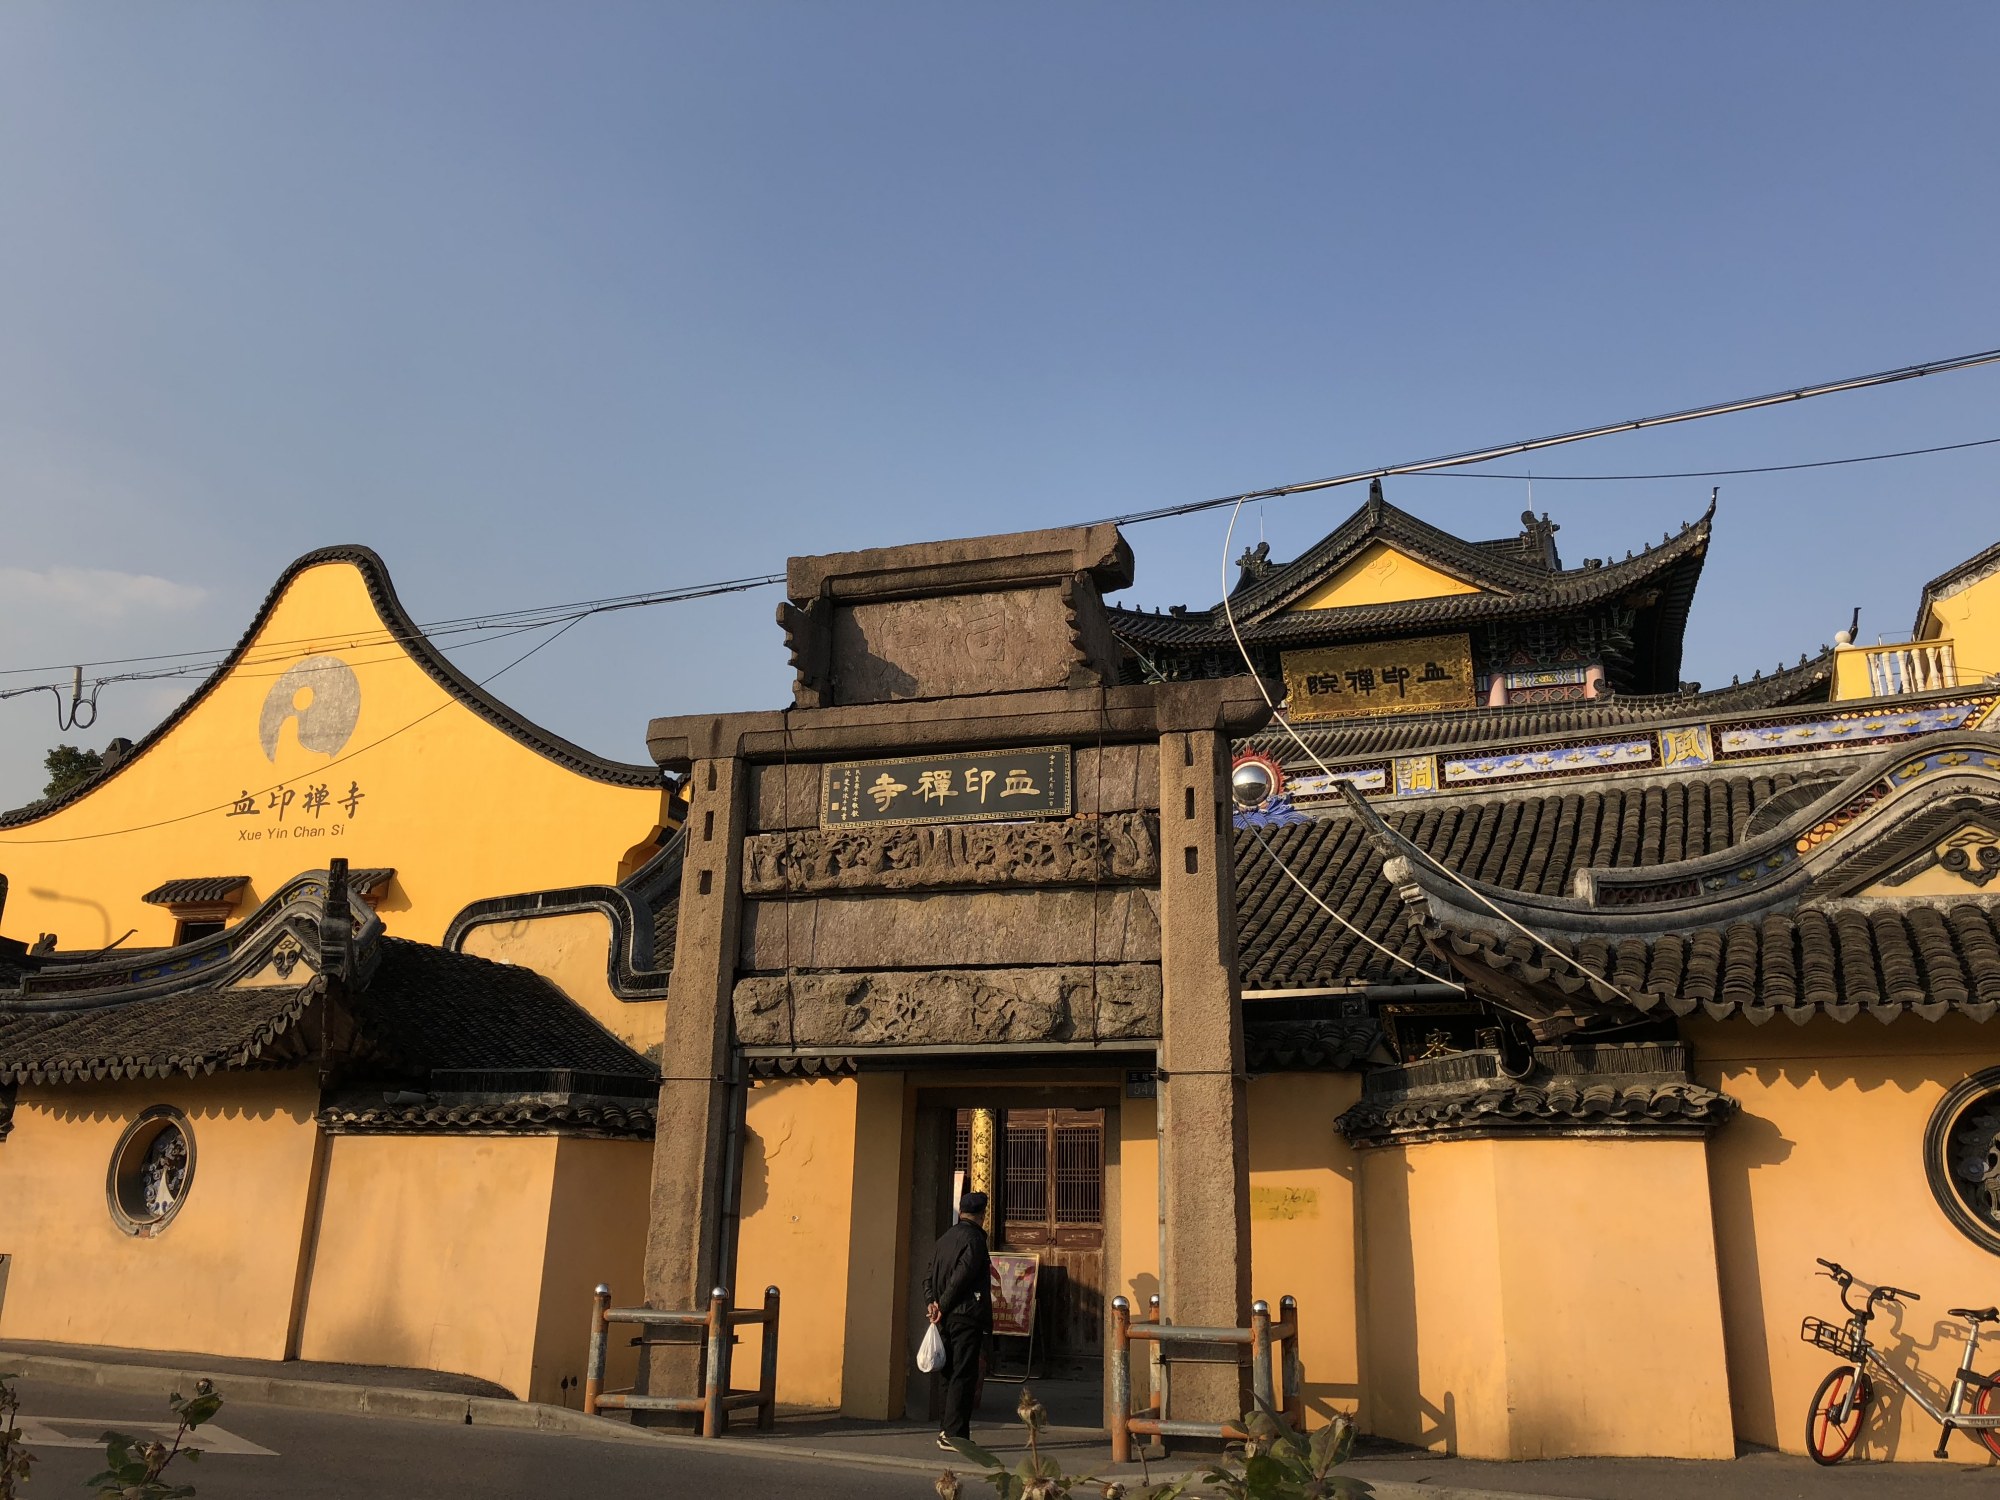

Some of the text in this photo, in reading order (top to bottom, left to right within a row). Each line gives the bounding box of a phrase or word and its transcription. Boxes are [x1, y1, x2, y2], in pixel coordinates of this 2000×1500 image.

[1666, 727, 1706, 763] 風
[226, 781, 365, 822] 血印禅寺
[866, 767, 1041, 812] 血印禪寺
[238, 824, 345, 841] Xue Yin Chan Si
